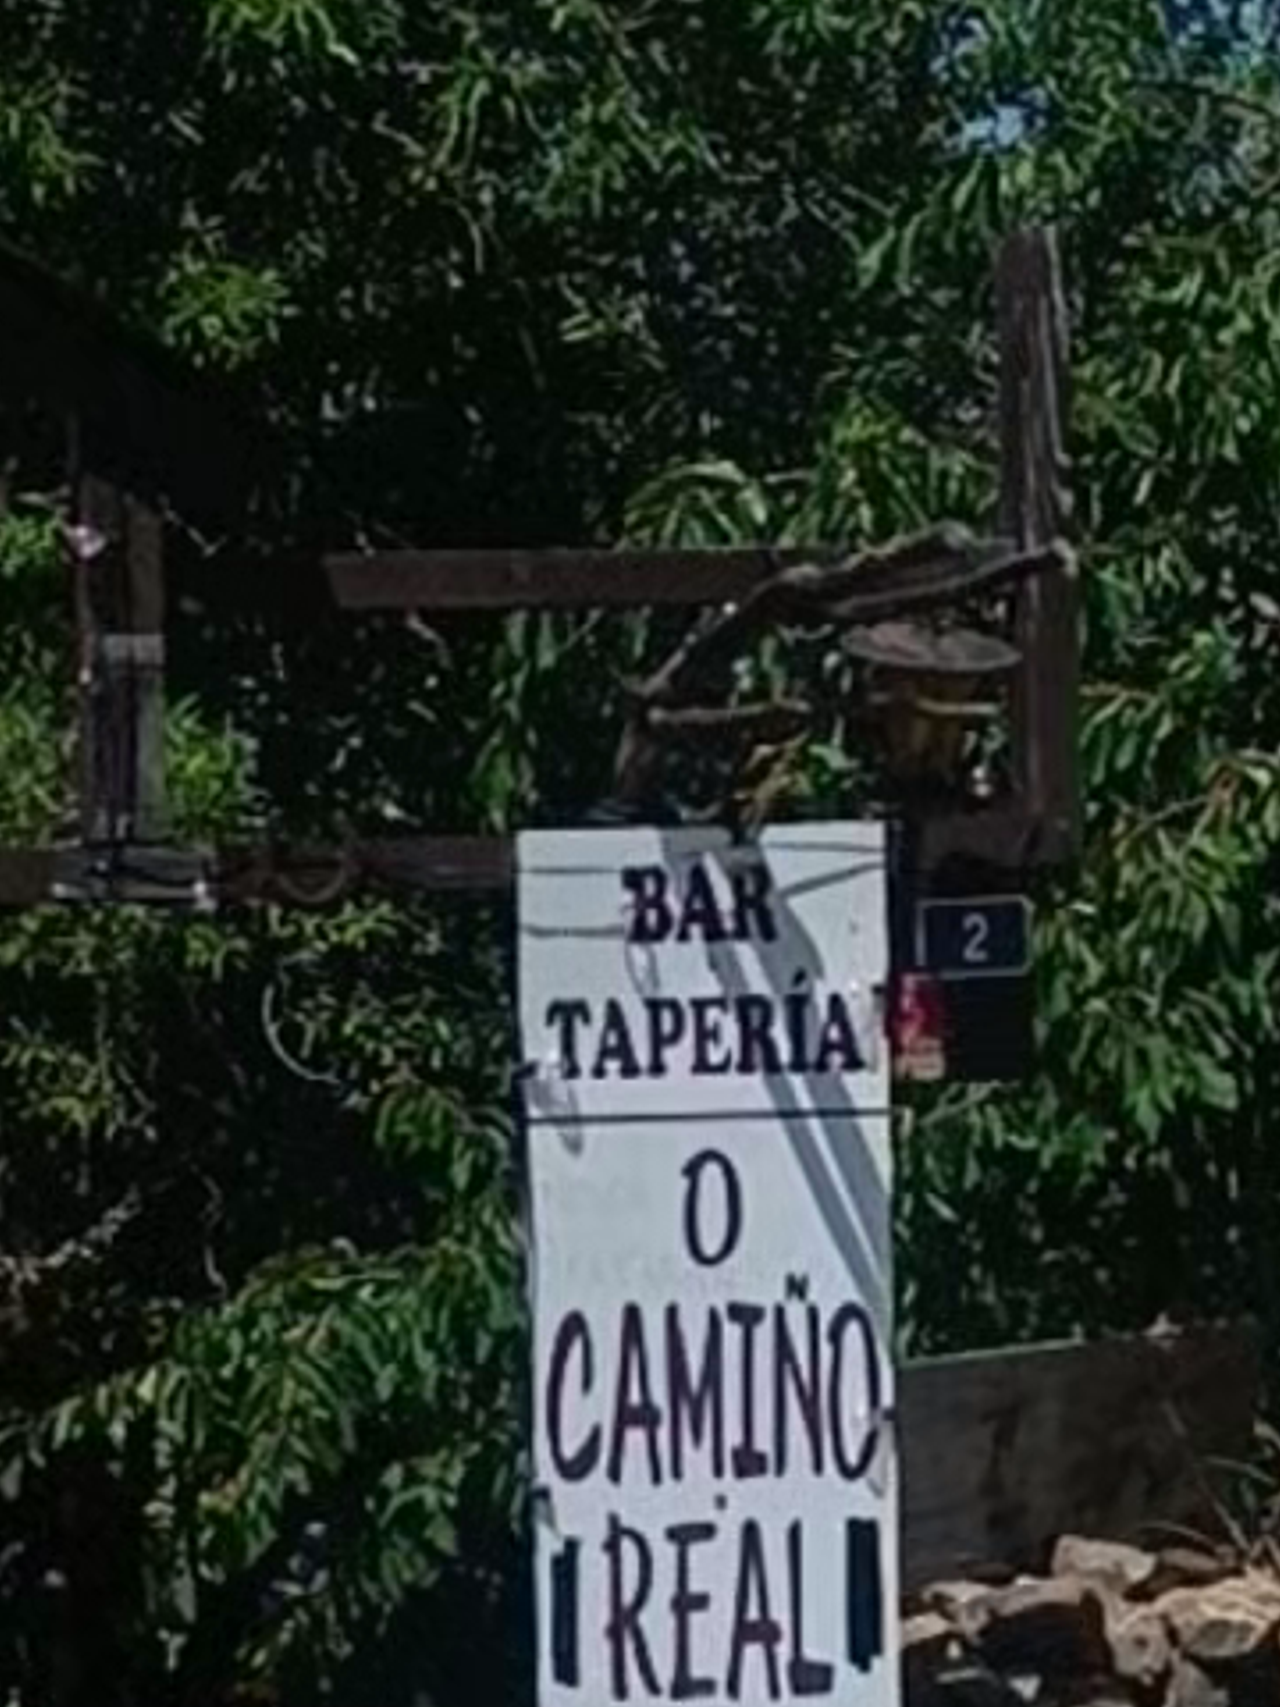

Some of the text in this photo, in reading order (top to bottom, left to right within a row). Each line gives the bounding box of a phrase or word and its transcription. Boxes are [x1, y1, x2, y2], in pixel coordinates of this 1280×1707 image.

[621, 858, 779, 944] BAR
[961, 912, 990, 962] 2
[546, 971, 865, 1082] TAPERÍA
[681, 1147, 744, 1267] O
[546, 1273, 882, 1486] CAMIÑO
[602, 1510, 836, 1702] REAL
